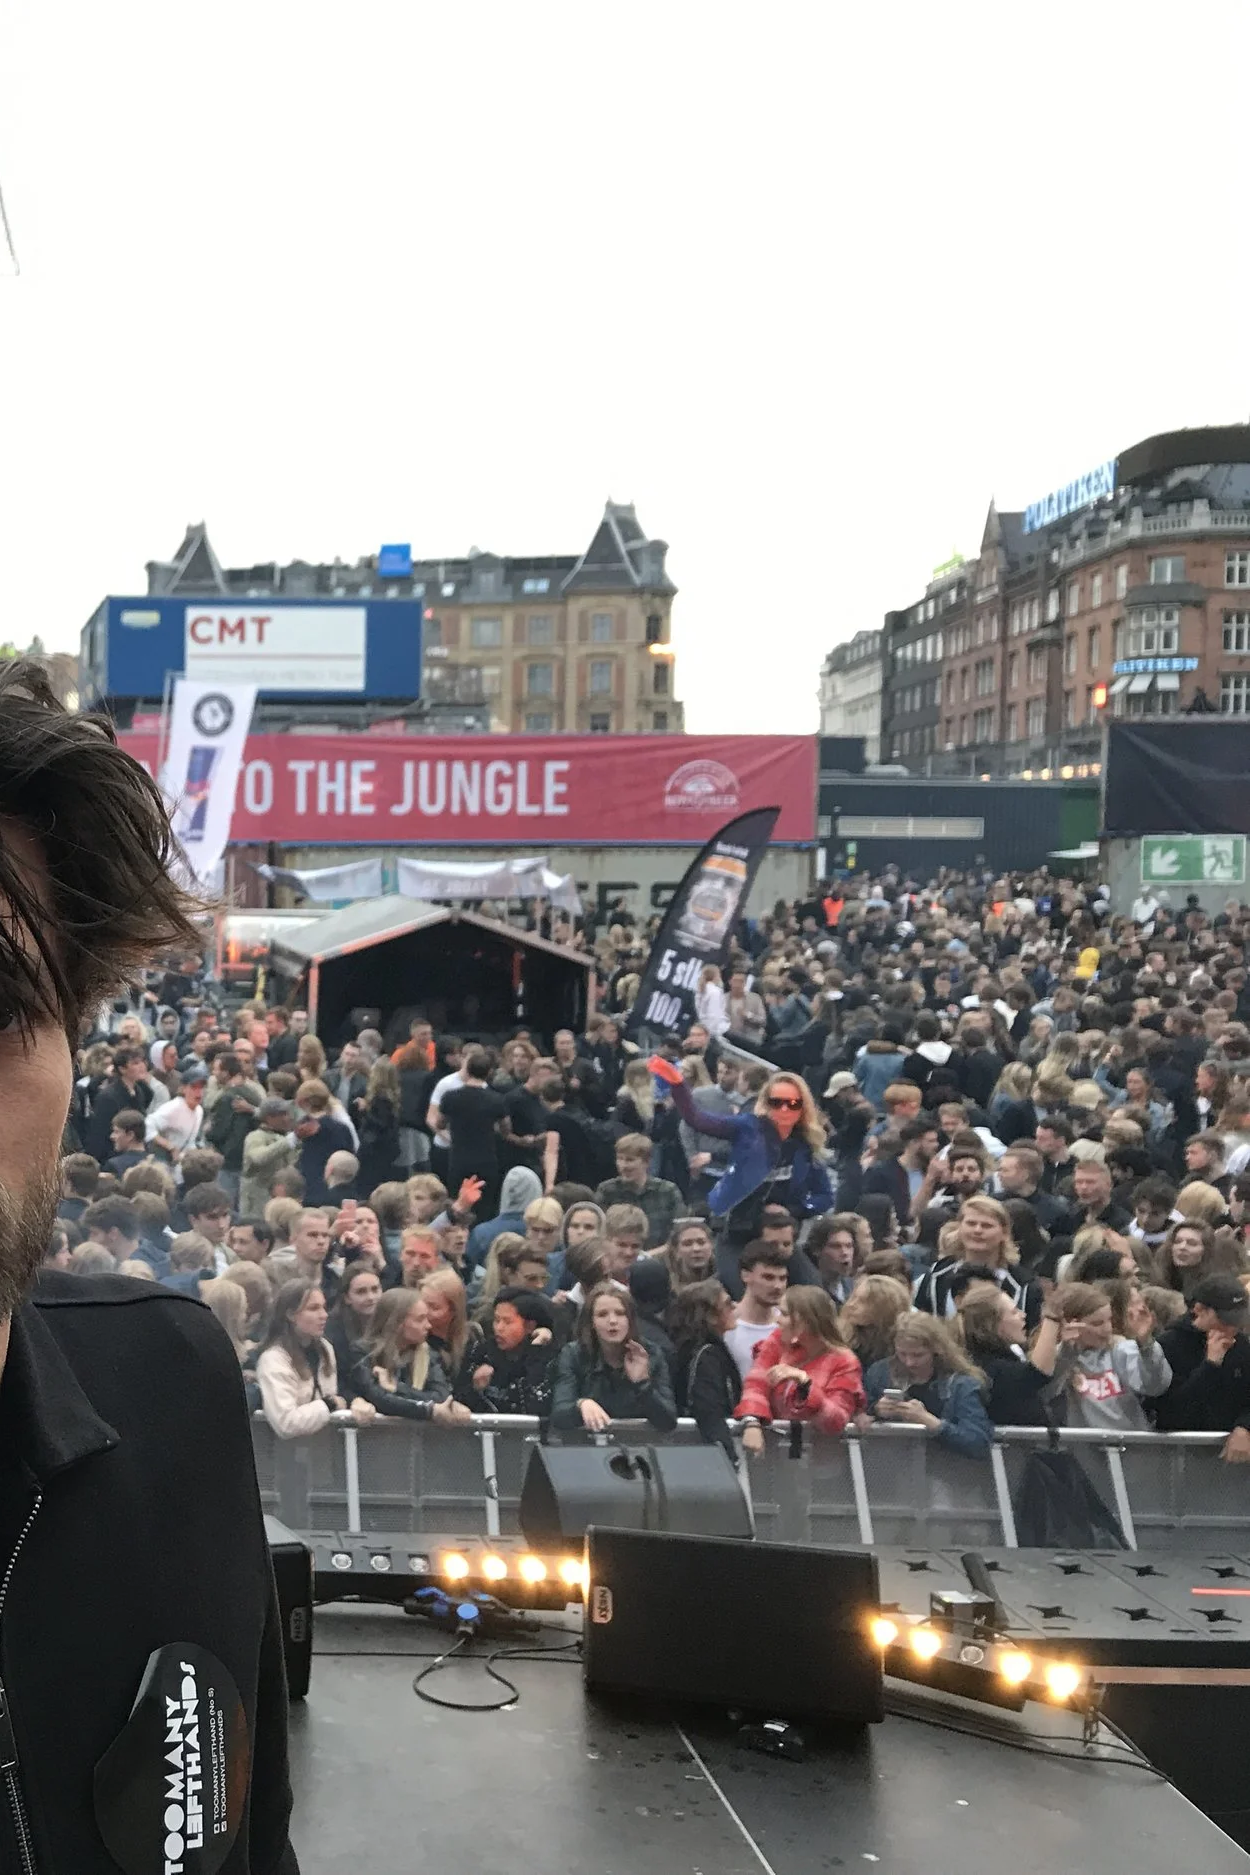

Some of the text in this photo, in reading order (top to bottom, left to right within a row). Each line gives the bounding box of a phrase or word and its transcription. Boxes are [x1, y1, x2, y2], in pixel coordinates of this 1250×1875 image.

[1022, 460, 1118, 535] POLITIKEN
[190, 616, 272, 644] CMT
[287, 760, 377, 816] THE
[389, 760, 570, 816] JUNGLE
[657, 948, 678, 982] 5
[163, 1695, 186, 1801] MANY
[209, 1716, 221, 1821] TOOMANYLEFTHAND
[216, 1709, 228, 1818] TOOMANYLEFTHANDS
